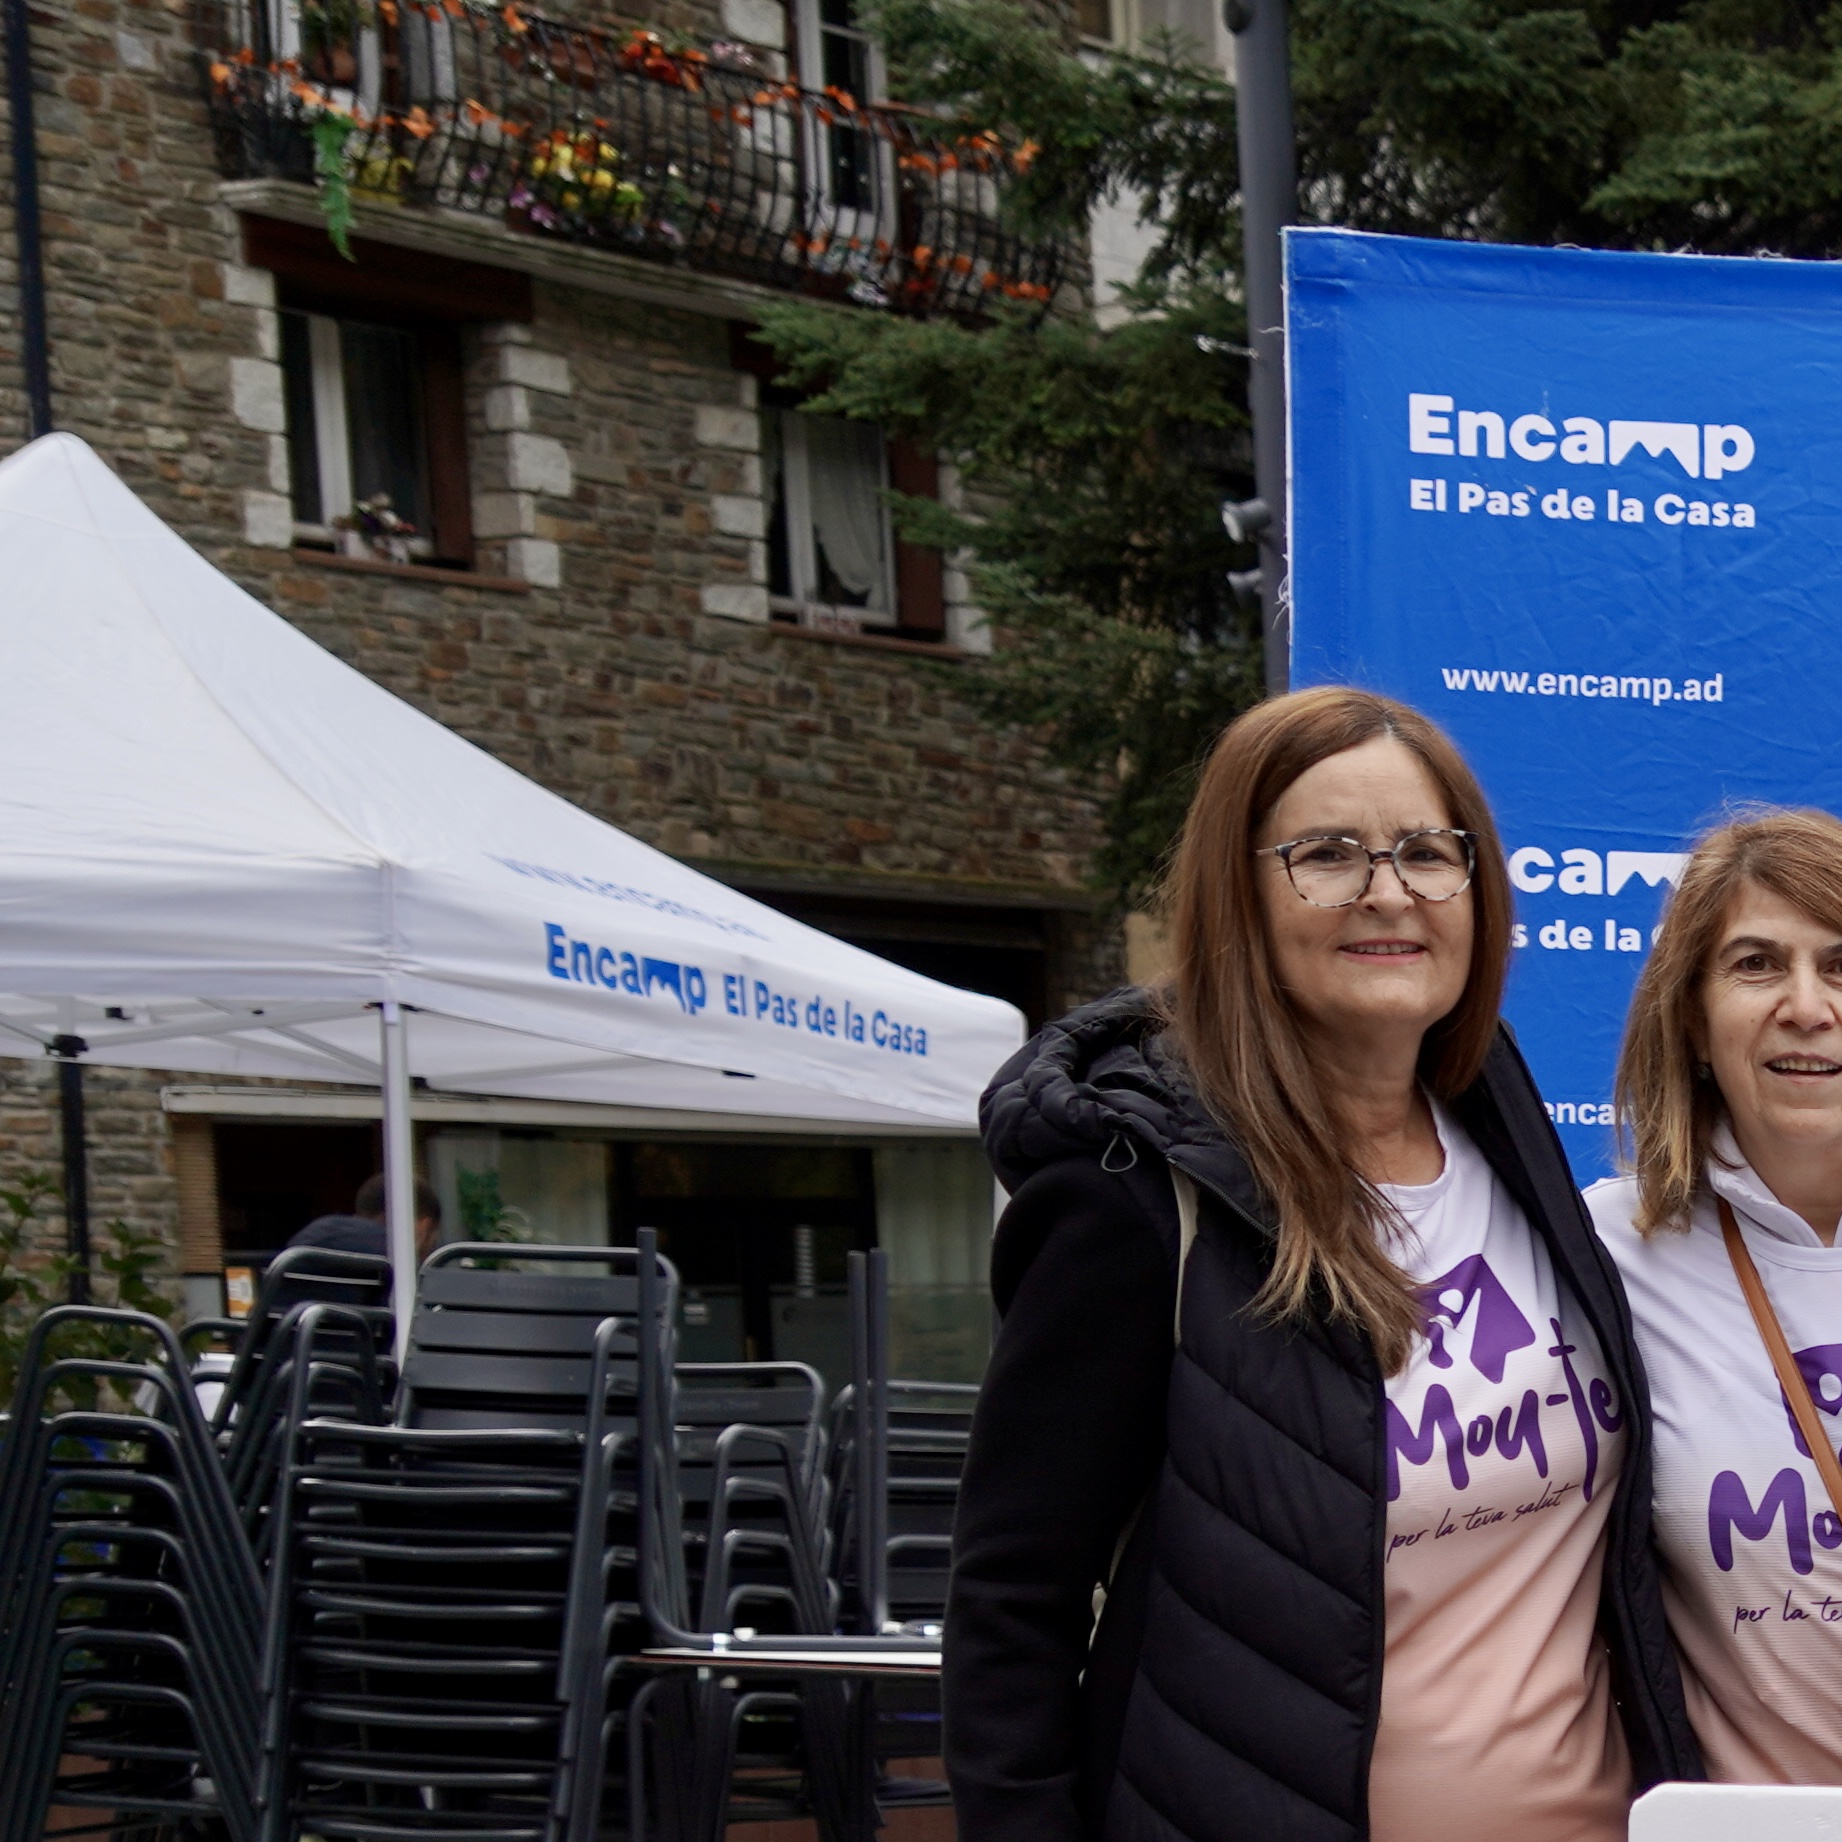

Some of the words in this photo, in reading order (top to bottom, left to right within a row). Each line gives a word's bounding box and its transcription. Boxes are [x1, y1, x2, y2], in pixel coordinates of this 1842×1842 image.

[1408, 392, 1755, 480] Encamp
[1410, 478, 1447, 512] El
[1458, 482, 1530, 517] Pas
[1540, 488, 1596, 521] de
[1607, 489, 1644, 523] la
[1654, 493, 1756, 528] Casa
[1441, 668, 1723, 706] www.encamp.ad
[1538, 919, 1595, 951] de
[1604, 919, 1643, 953] la
[543, 921, 707, 1016] Encamp
[723, 973, 748, 1017] El
[755, 980, 798, 1029] Pas
[805, 995, 836, 1038] de
[844, 1000, 865, 1044] la
[872, 1009, 928, 1057] Casa
[1386, 1527, 1430, 1563] per
[1434, 1506, 1458, 1541] la
[1461, 1504, 1508, 1533] teva
[1509, 1478, 1581, 1523] salut
[1733, 1603, 1772, 1635] per
[1783, 1588, 1811, 1621] la
